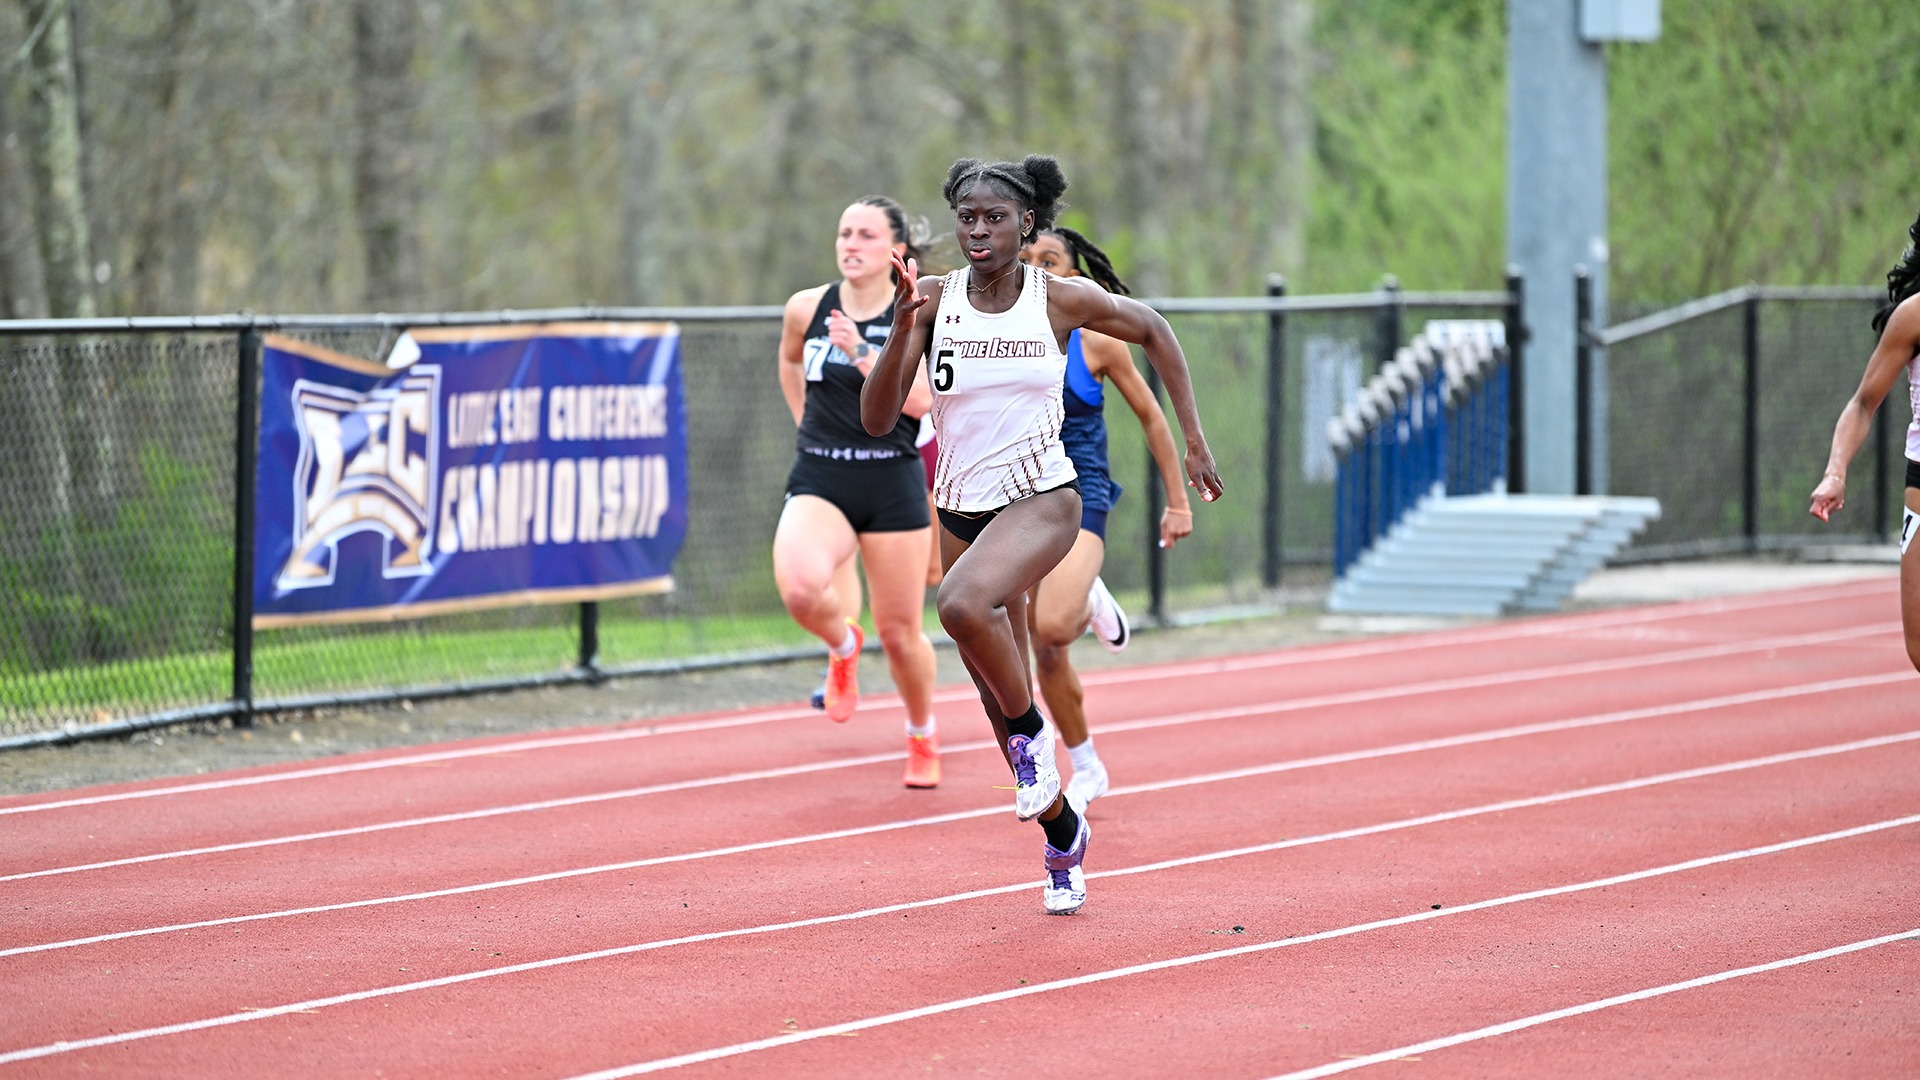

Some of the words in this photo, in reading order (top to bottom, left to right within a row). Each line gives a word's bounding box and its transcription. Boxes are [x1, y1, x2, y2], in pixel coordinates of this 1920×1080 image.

[809, 344, 823, 376] 7
[988, 337, 1045, 358] ISLAND
[933, 349, 955, 392] 5
[548, 384, 668, 441] CONFERENCE
[437, 454, 669, 554] CHAMPIONSHIP
